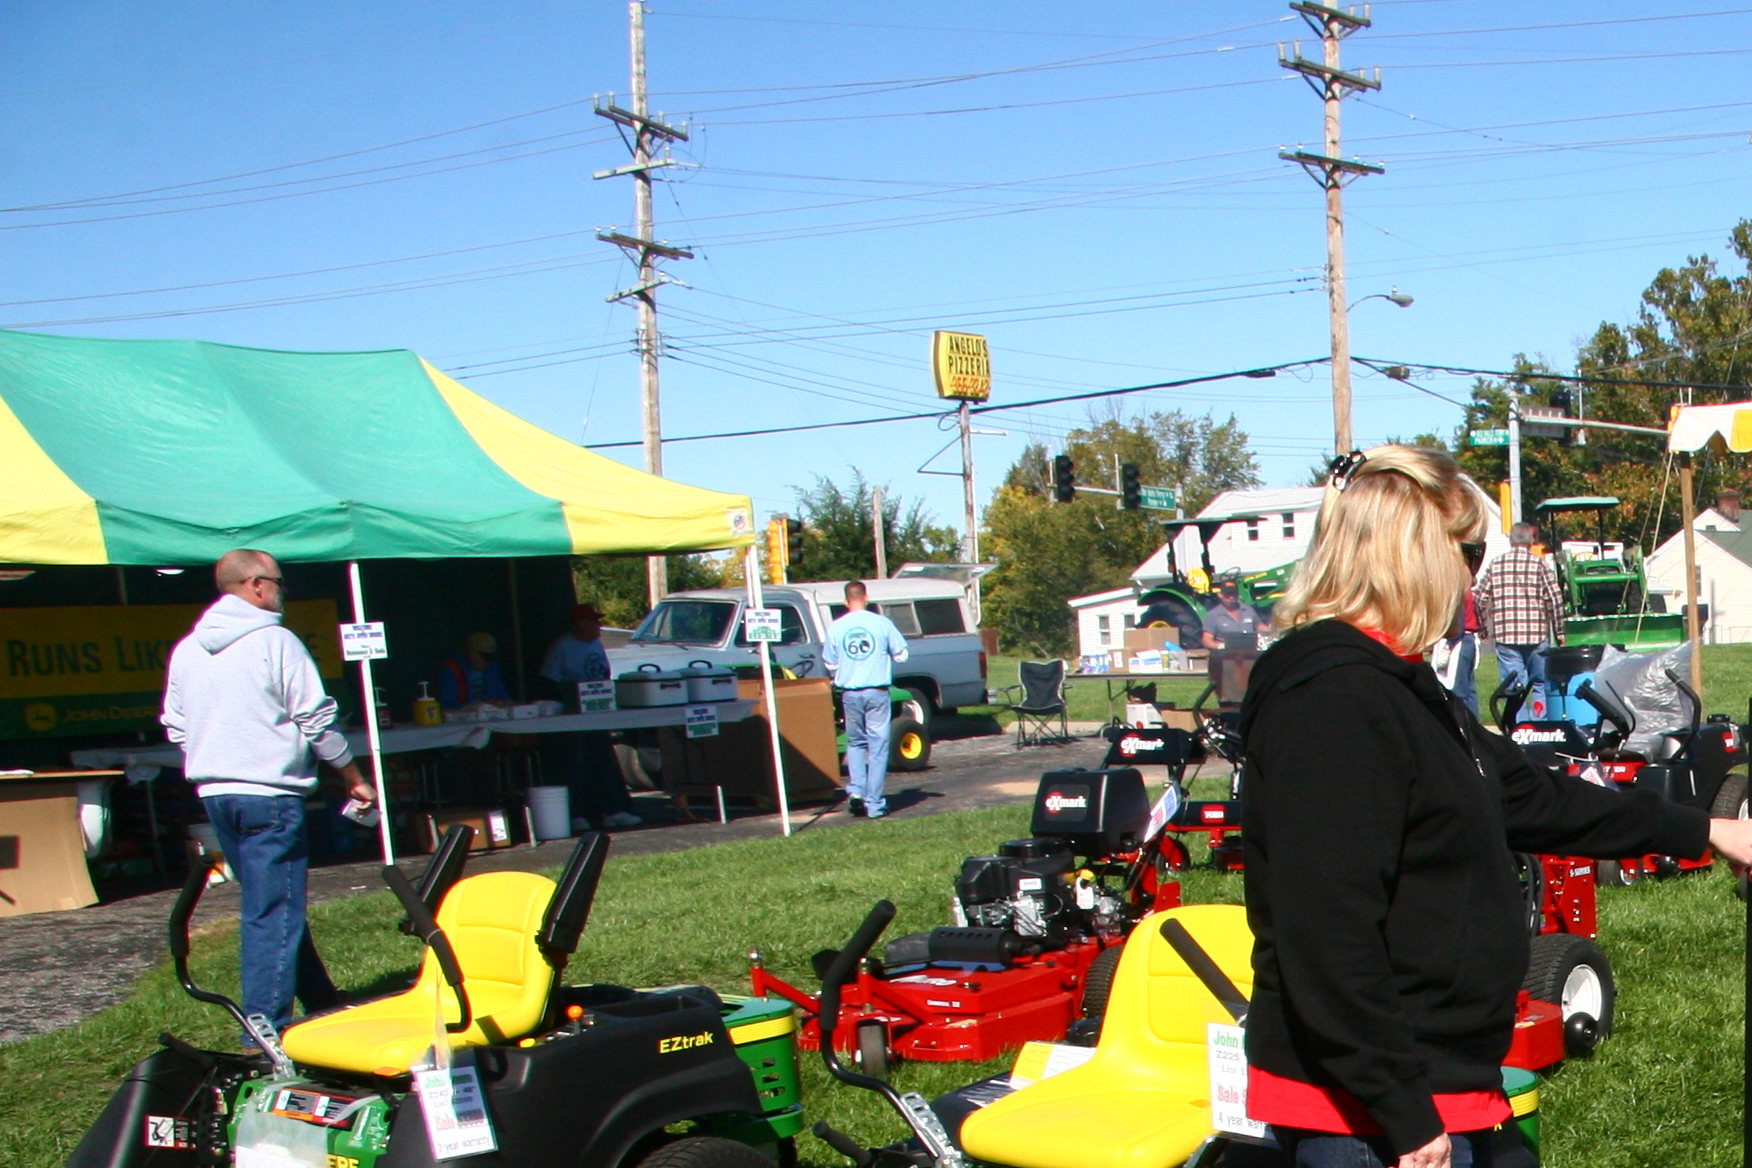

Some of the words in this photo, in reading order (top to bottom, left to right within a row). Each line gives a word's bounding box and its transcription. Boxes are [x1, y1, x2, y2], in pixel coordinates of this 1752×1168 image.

[7, 639, 102, 677] RUNS
[114, 635, 172, 672] LIK
[659, 1031, 714, 1054] EZtrak
[1213, 1030, 1239, 1048] John
[1216, 1050, 1240, 1061] Z225
[1216, 1083, 1239, 1105] Sale
[1226, 1113, 1243, 1128] year
